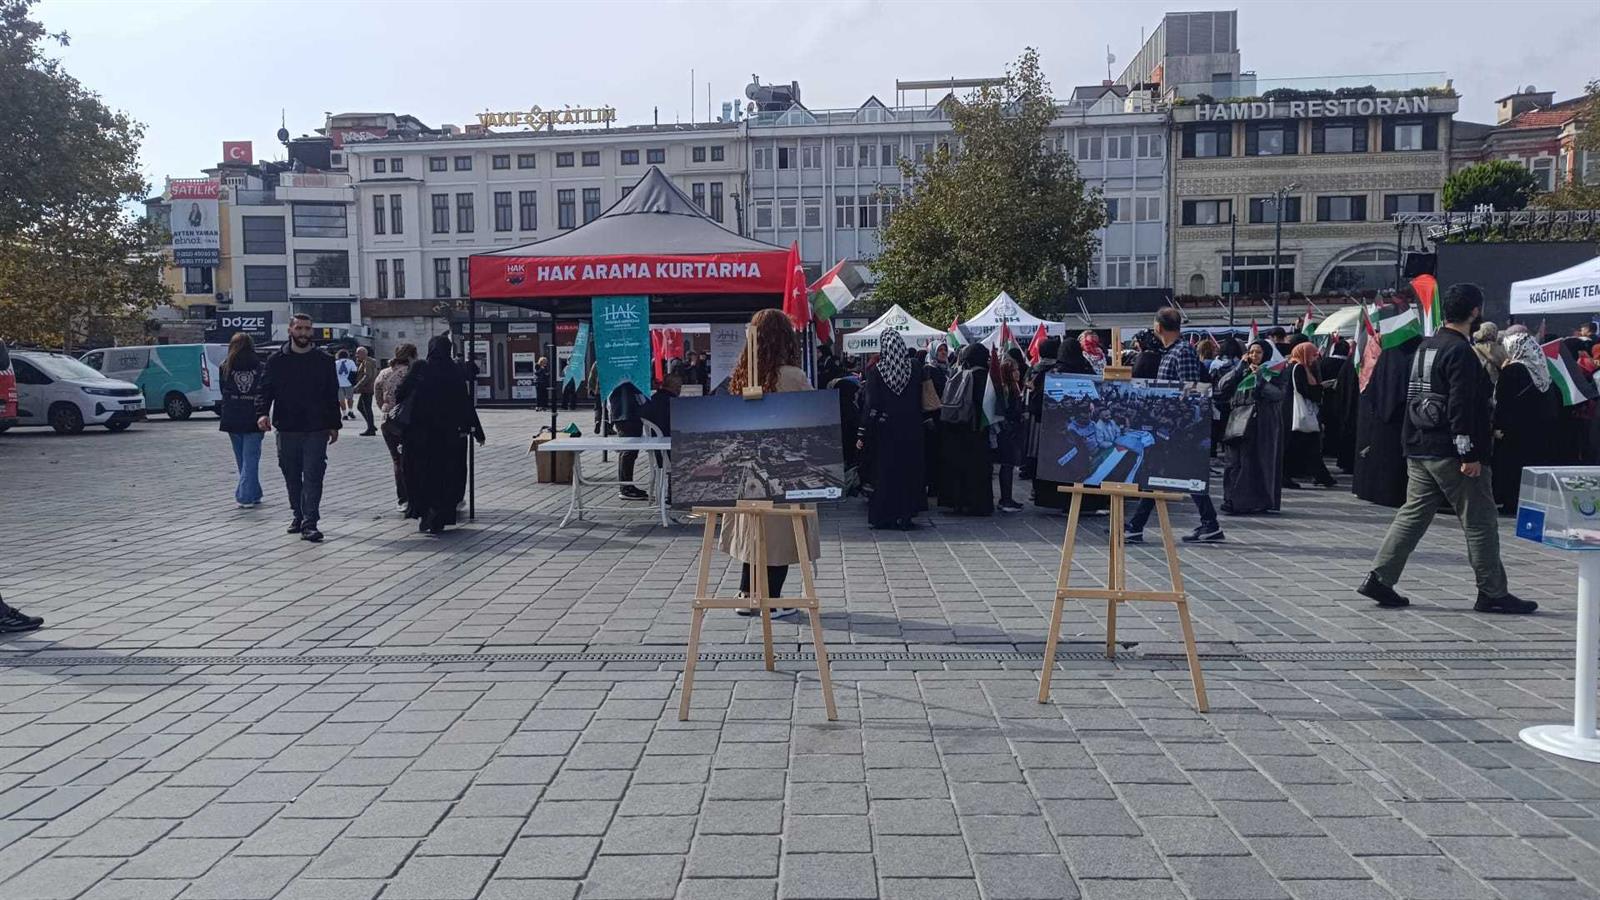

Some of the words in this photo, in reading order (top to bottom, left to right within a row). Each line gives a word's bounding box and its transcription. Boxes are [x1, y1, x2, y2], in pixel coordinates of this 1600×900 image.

[479, 112, 521, 127] VAKIF
[551, 107, 616, 124] KATILIM
[1195, 97, 1275, 121] HAMDİ
[1290, 96, 1429, 118] RESTORAN
[171, 184, 217, 196] SATILIK
[507, 264, 525, 272] HAK
[537, 265, 576, 281] HAK
[581, 263, 651, 280] ARAMA
[656, 262, 761, 279] KURTARMA
[1529, 287, 1581, 304] KAĞITHANE
[603, 303, 640, 321] HAK
